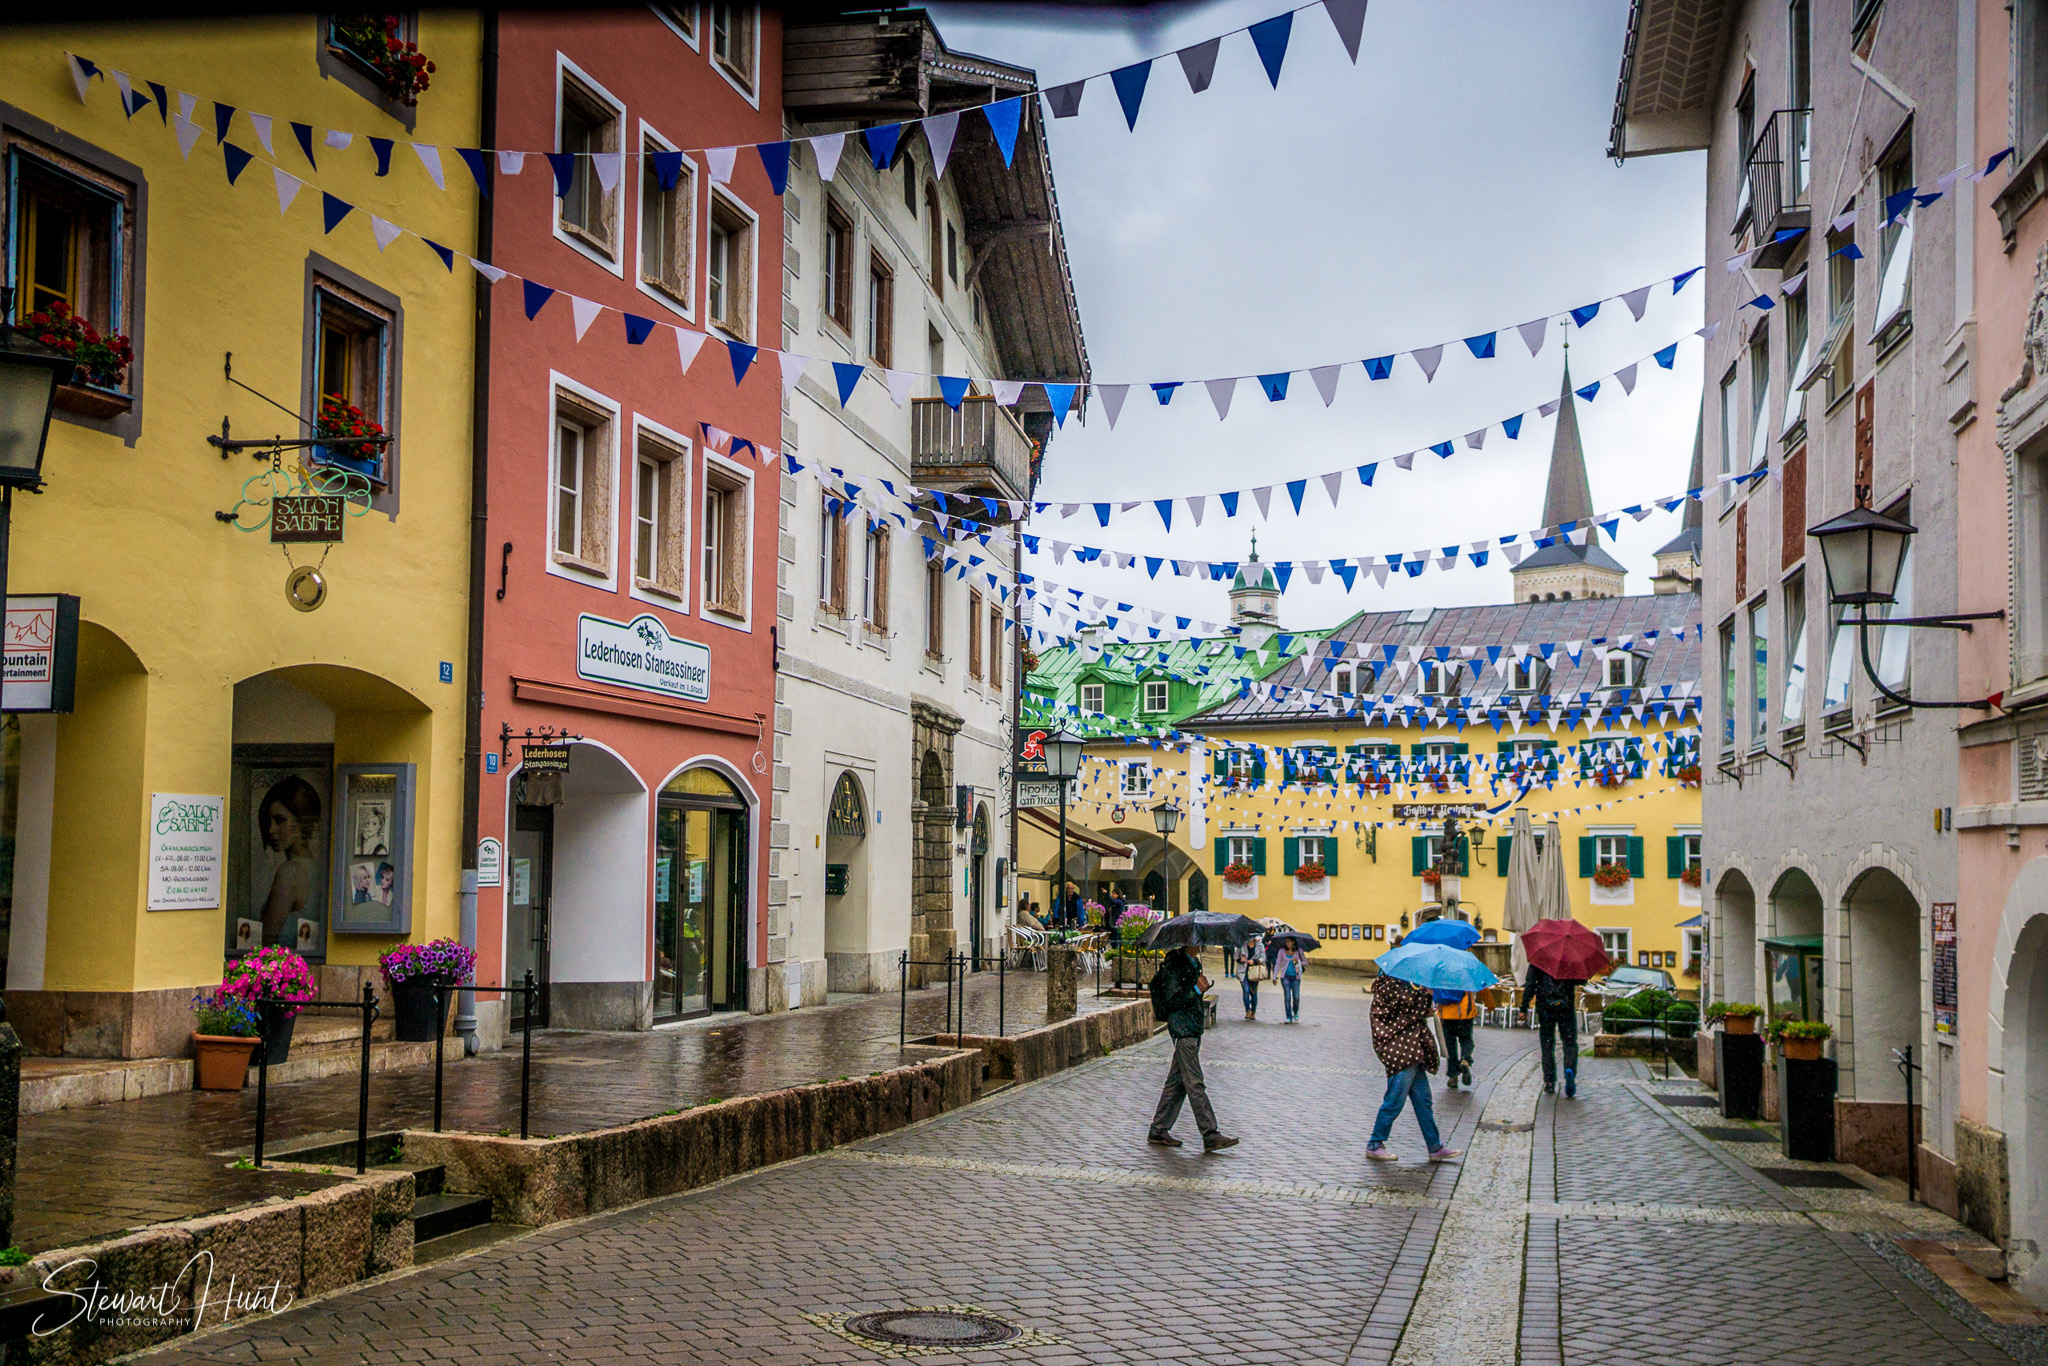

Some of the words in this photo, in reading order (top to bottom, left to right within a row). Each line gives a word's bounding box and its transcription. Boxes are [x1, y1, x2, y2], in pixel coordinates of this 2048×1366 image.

[278, 498, 339, 514] SALON
[275, 515, 340, 531] SABINE
[2, 652, 47, 666] ountain
[584, 637, 642, 670] Lederhosen
[644, 651, 706, 683] Stangassinger
[2, 668, 46, 677] ertainment
[442, 663, 450, 676] 12
[524, 747, 567, 758] Lederhosen
[489, 755, 496, 766] 10
[523, 759, 568, 770] Stangassinger
[1020, 783, 1060, 796] Apothek
[1037, 796, 1060, 805] Mar
[178, 804, 219, 819] SALON
[170, 818, 213, 832] SABINE
